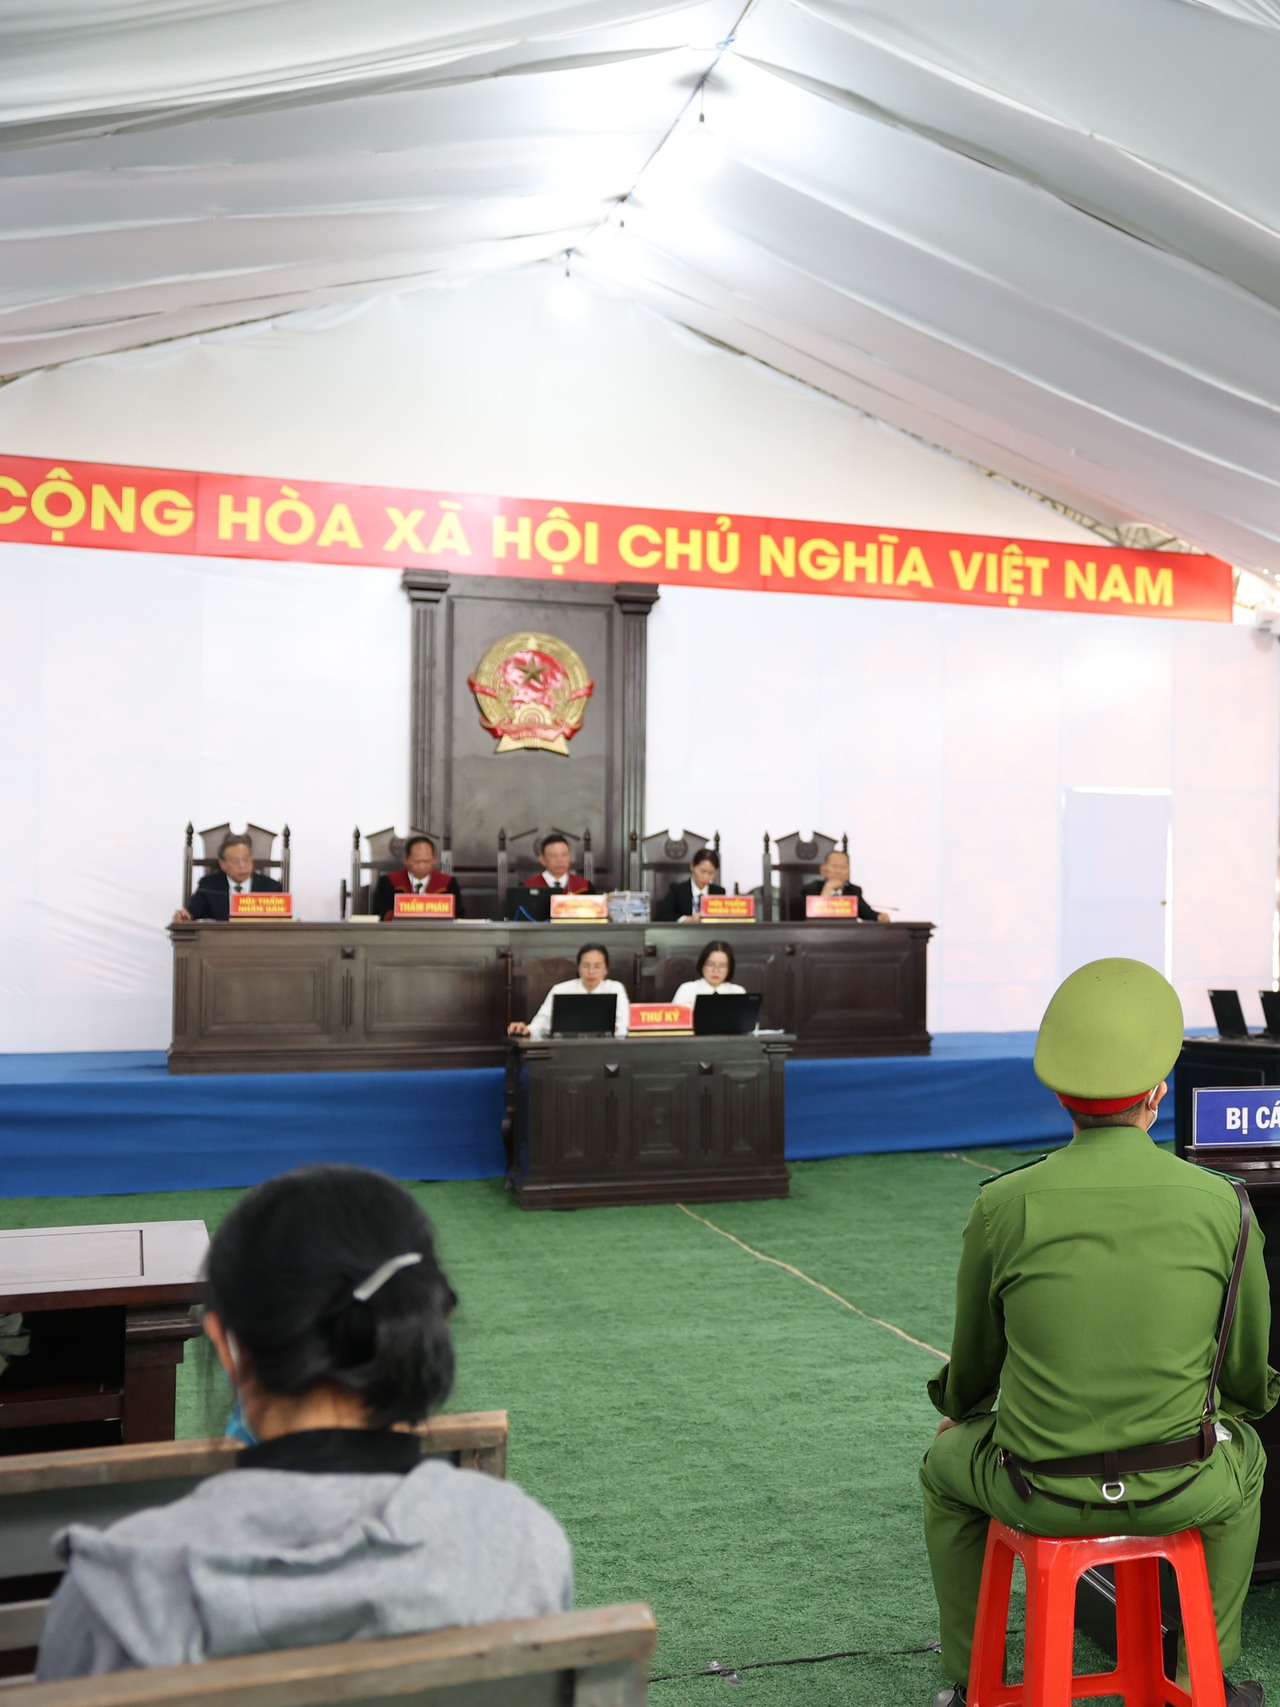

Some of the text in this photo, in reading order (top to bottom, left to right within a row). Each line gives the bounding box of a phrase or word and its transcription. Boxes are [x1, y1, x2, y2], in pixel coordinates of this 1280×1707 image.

[0, 467, 1174, 607] CỘNG HÒA XÃ HỘI CHỦ NGHĨA VIỆT NAM
[640, 1009, 663, 1023] THƯ
[1226, 1107, 1248, 1134] BỊ
